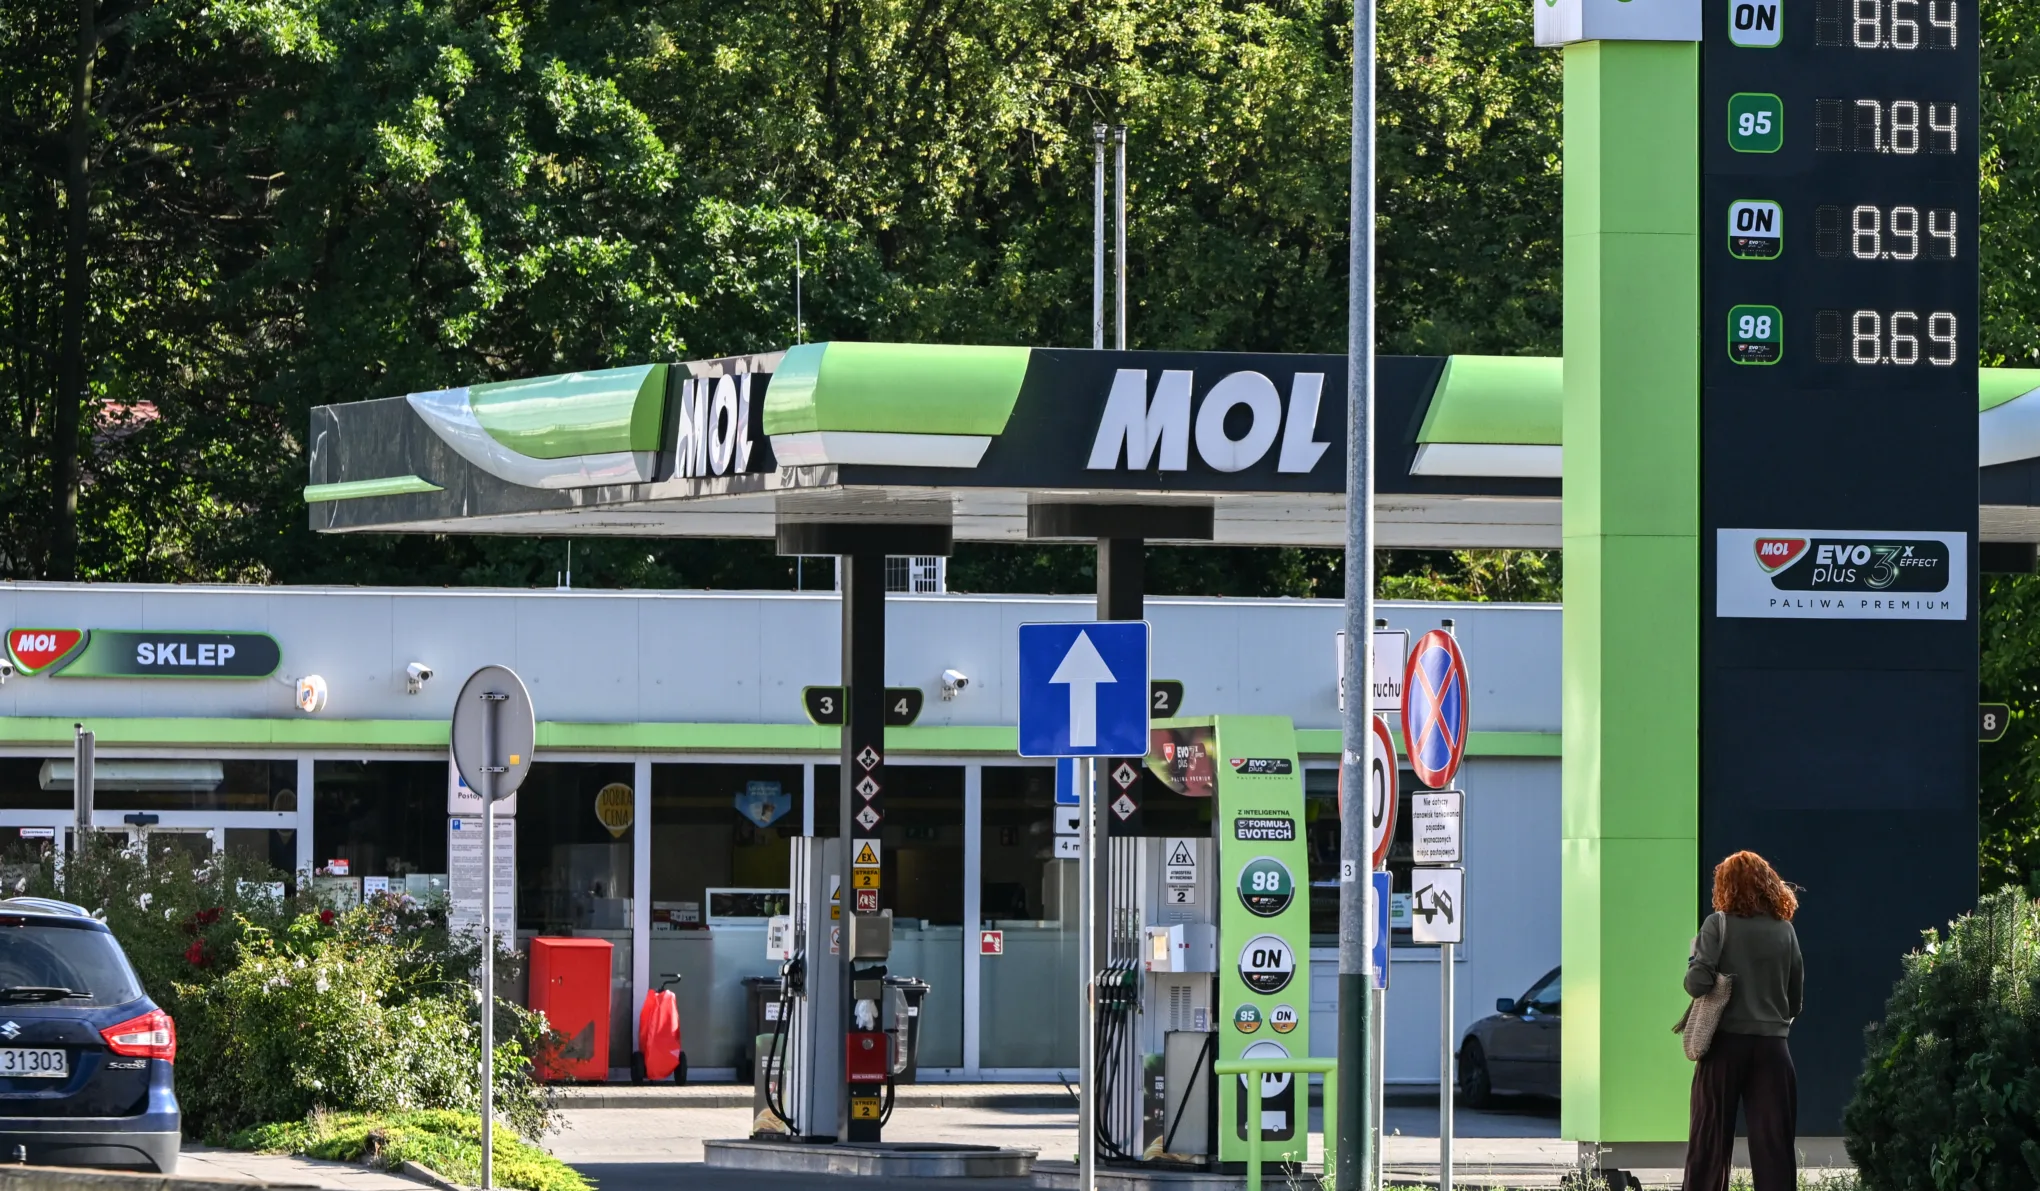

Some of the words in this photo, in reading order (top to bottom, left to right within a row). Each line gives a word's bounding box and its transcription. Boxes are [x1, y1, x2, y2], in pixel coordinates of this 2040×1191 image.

[1735, 4, 1776, 31] ON
[1853, 0, 1957, 49] 8.64
[1738, 111, 1772, 136] 95
[1856, 100, 1957, 153] 7.84
[1737, 208, 1774, 232] ON
[1853, 205, 1957, 260] 8.94
[1739, 315, 1771, 339] 98
[1853, 310, 1957, 365] 8.69
[674, 372, 754, 478] MOL
[1087, 368, 1331, 473] MOL
[1760, 543, 1789, 555] MOL
[1816, 545, 1871, 565] EVO
[1899, 558, 1938, 567] EFFECT
[1812, 564, 1856, 586] plus
[1770, 598, 1845, 609] PALIWA
[1861, 600, 1950, 610] PREMIUM
[17, 634, 57, 652] MOL
[137, 642, 236, 666] SKLEP
[1373, 677, 1400, 697] ruchu
[820, 696, 834, 714] 3
[894, 697, 909, 715] 4
[1154, 690, 1168, 709] 2
[1983, 713, 1996, 730] 8
[1177, 745, 1189, 758] EVO
[1178, 757, 1188, 769] plus
[604, 809, 628, 826] CENA
[1249, 820, 1291, 829] FORMUŁĄ
[1238, 829, 1292, 838] EVOTECH
[1062, 841, 1068, 850] 4
[862, 853, 872, 862] EX
[1176, 853, 1187, 863] EX
[1344, 864, 1352, 877] 3
[863, 876, 871, 885] 2
[1252, 871, 1279, 891] 98
[1177, 891, 1186, 902] 2
[1252, 949, 1282, 968] ON
[1240, 1010, 1255, 1021] 95
[1276, 1011, 1291, 1021] ON
[4, 1050, 63, 1071] 31303
[862, 1107, 870, 1116] 2
